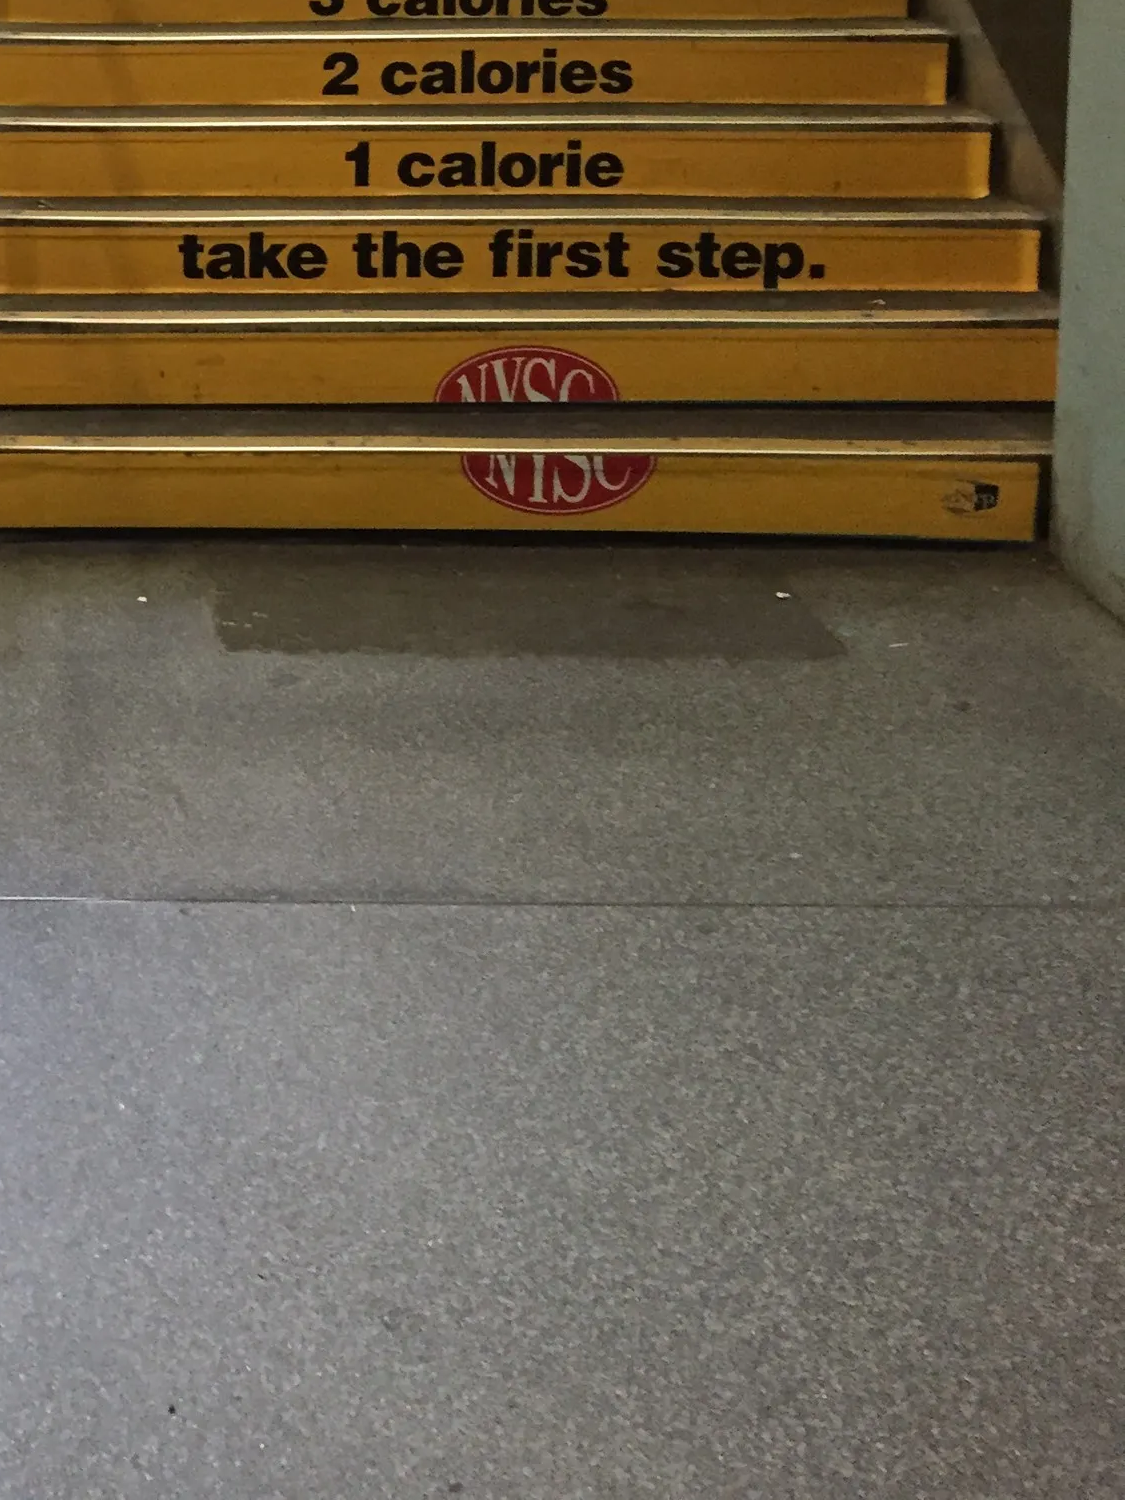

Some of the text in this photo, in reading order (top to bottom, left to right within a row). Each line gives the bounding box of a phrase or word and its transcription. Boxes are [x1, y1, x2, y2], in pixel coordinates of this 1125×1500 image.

[322, 47, 633, 96] 2 calories
[345, 140, 625, 188] 1 calorie
[179, 228, 826, 290] take the first step.
